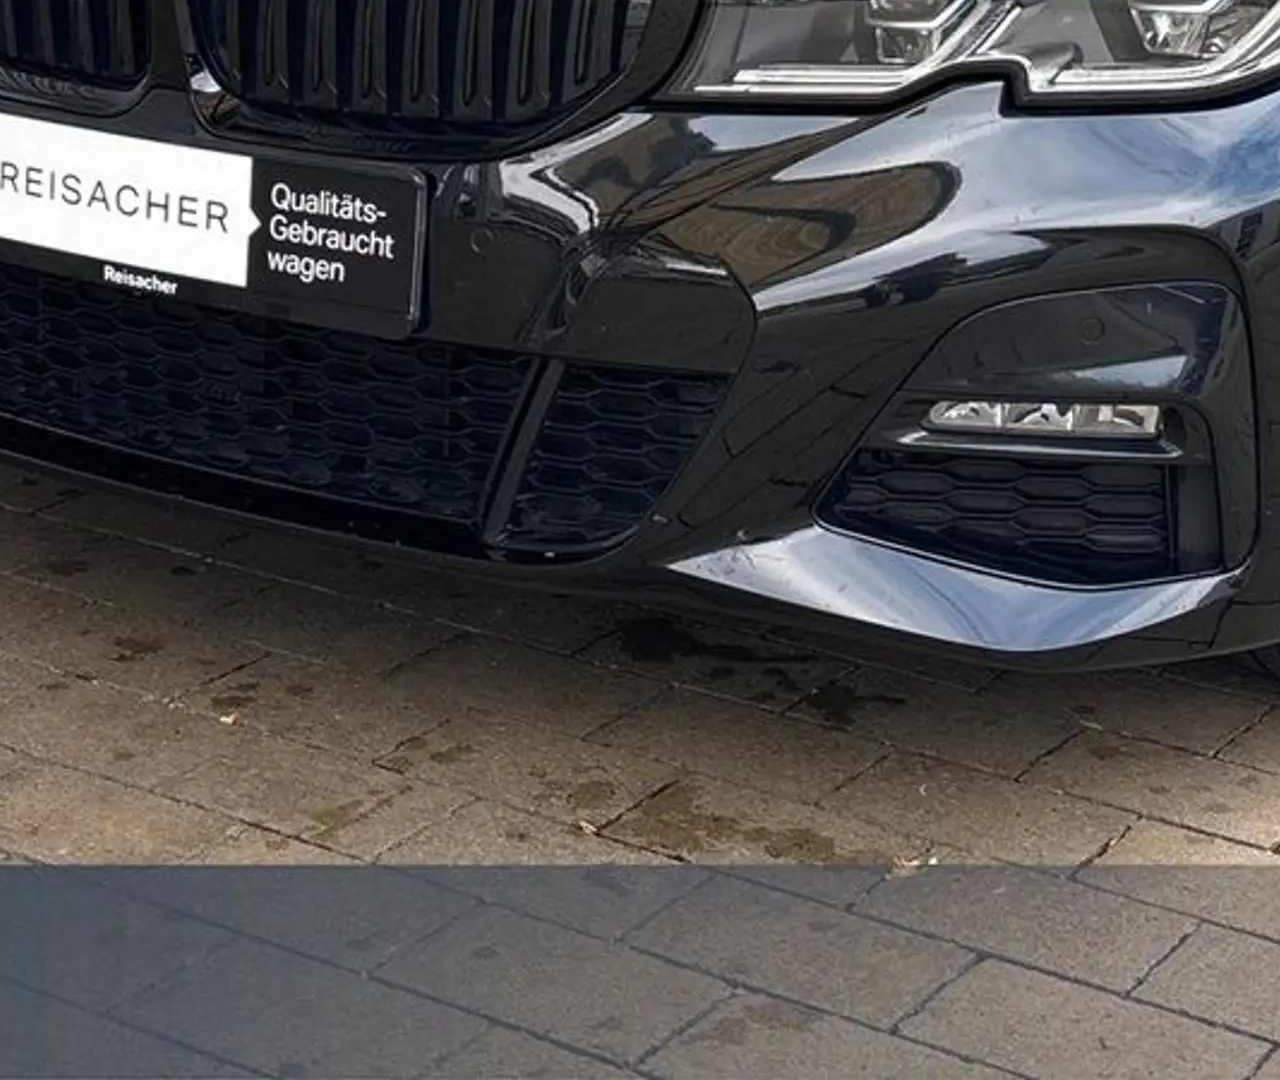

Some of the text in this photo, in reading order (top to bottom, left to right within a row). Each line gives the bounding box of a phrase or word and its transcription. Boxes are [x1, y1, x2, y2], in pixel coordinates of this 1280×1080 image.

[271, 182, 388, 225] Qualitäts-
[270, 214, 396, 260] Gebraucht
[103, 264, 179, 296] Reisacher
[267, 249, 346, 284] wagen
